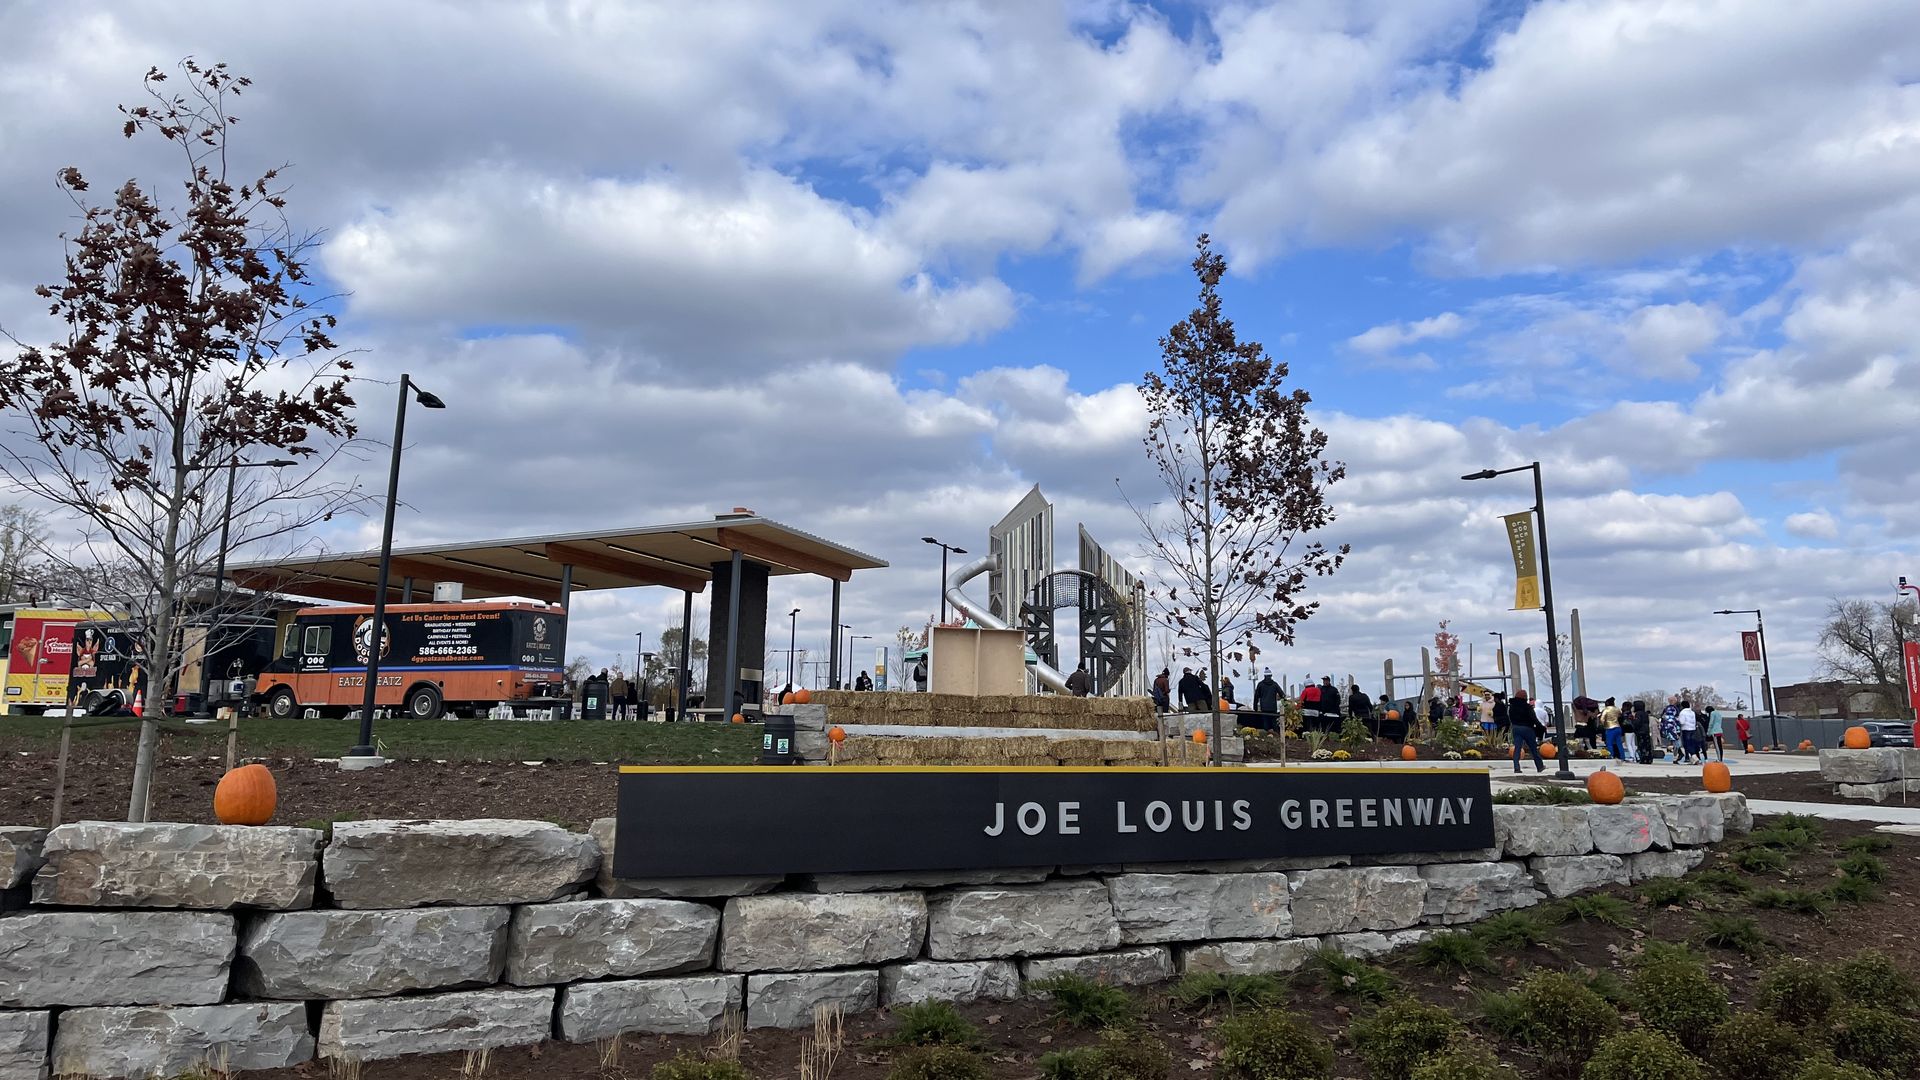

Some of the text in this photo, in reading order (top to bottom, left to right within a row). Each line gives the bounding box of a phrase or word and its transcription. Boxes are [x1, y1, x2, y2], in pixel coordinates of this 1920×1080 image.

[1512, 522, 1524, 570] GREENWAY
[1517, 522, 1526, 546] LOUIS
[419, 646, 477, 655] 586-666-2365
[339, 676, 402, 686] EATZ EATZ
[983, 797, 1475, 837] JOE LOUIS GREENWAY
